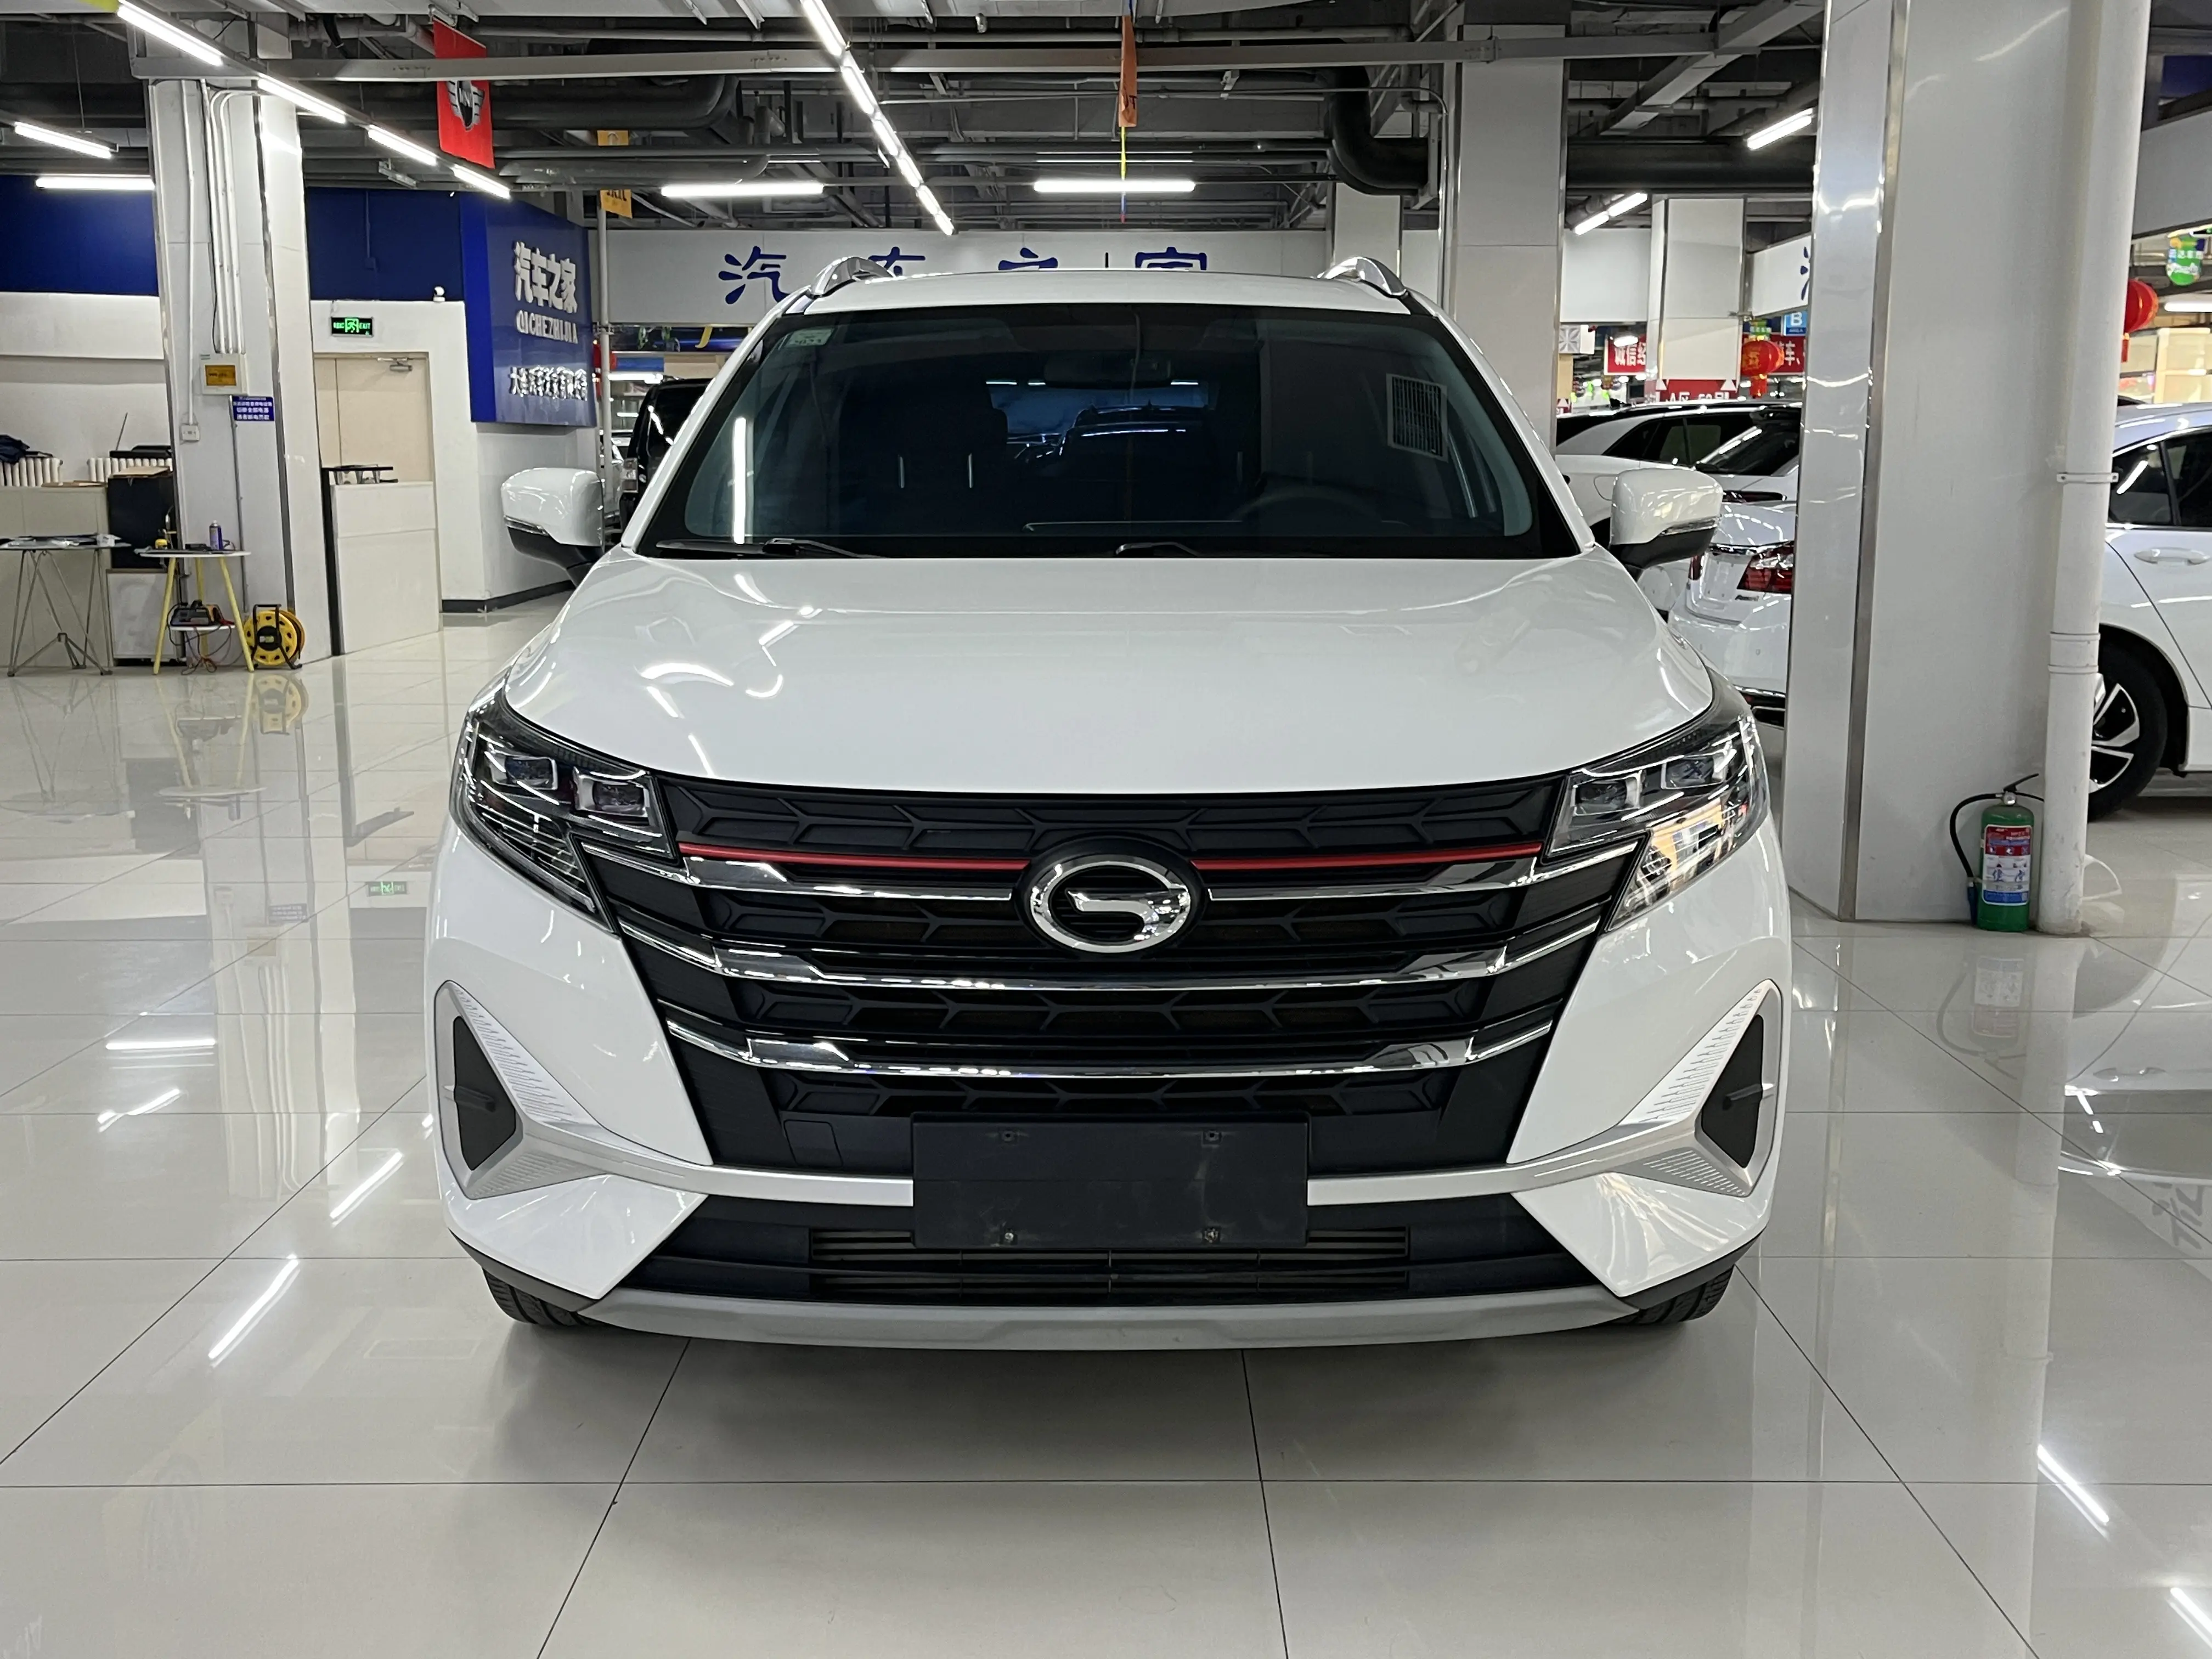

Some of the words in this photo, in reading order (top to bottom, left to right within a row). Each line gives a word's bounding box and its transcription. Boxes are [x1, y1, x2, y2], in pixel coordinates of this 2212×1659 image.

[512, 241, 578, 313] 汽车之家
[516, 310, 578, 344] QICHEZHIJIA
[1791, 312, 1803, 326] B
